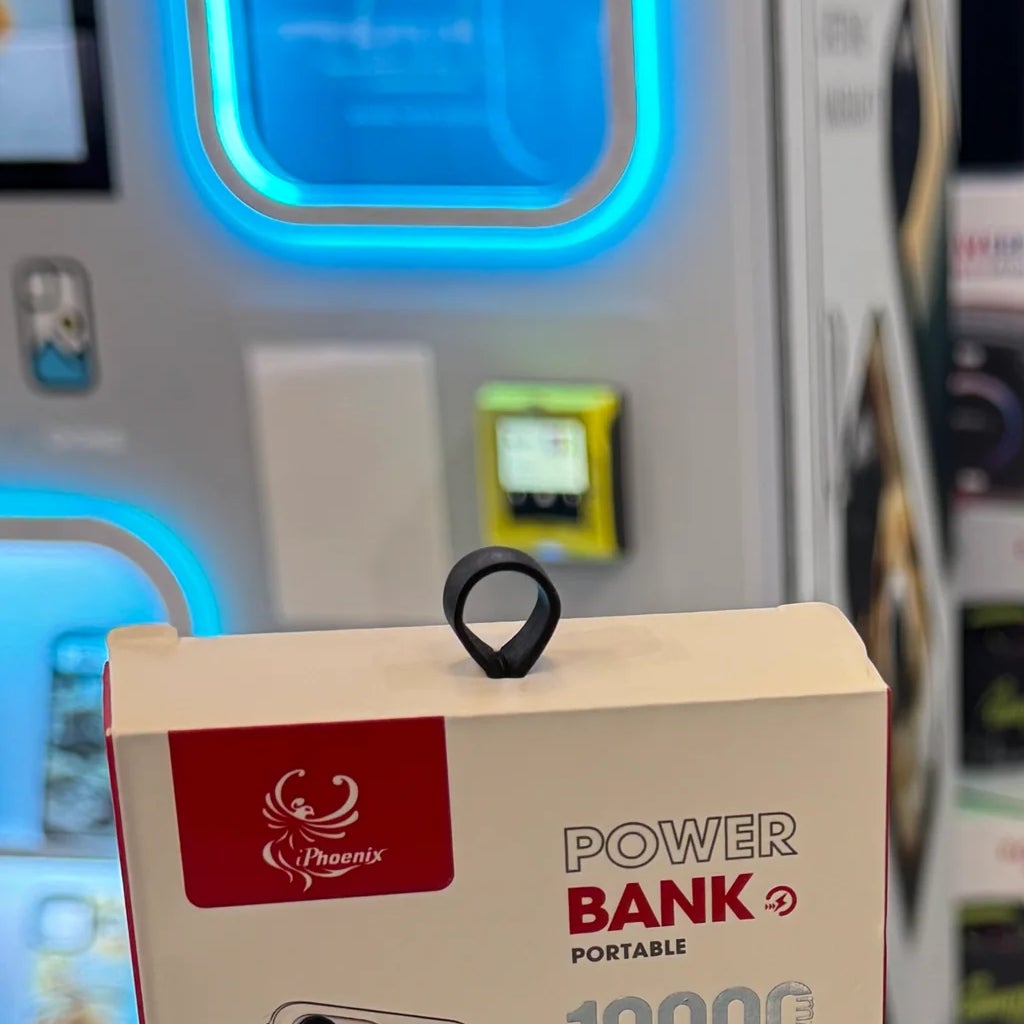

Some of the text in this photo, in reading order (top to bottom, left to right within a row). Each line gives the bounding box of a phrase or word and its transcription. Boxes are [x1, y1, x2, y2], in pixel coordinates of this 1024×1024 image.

[295, 846, 388, 867] iPhoenix
[563, 811, 798, 873] POWER
[567, 872, 755, 935] BANK
[571, 938, 687, 964] PORTABLE
